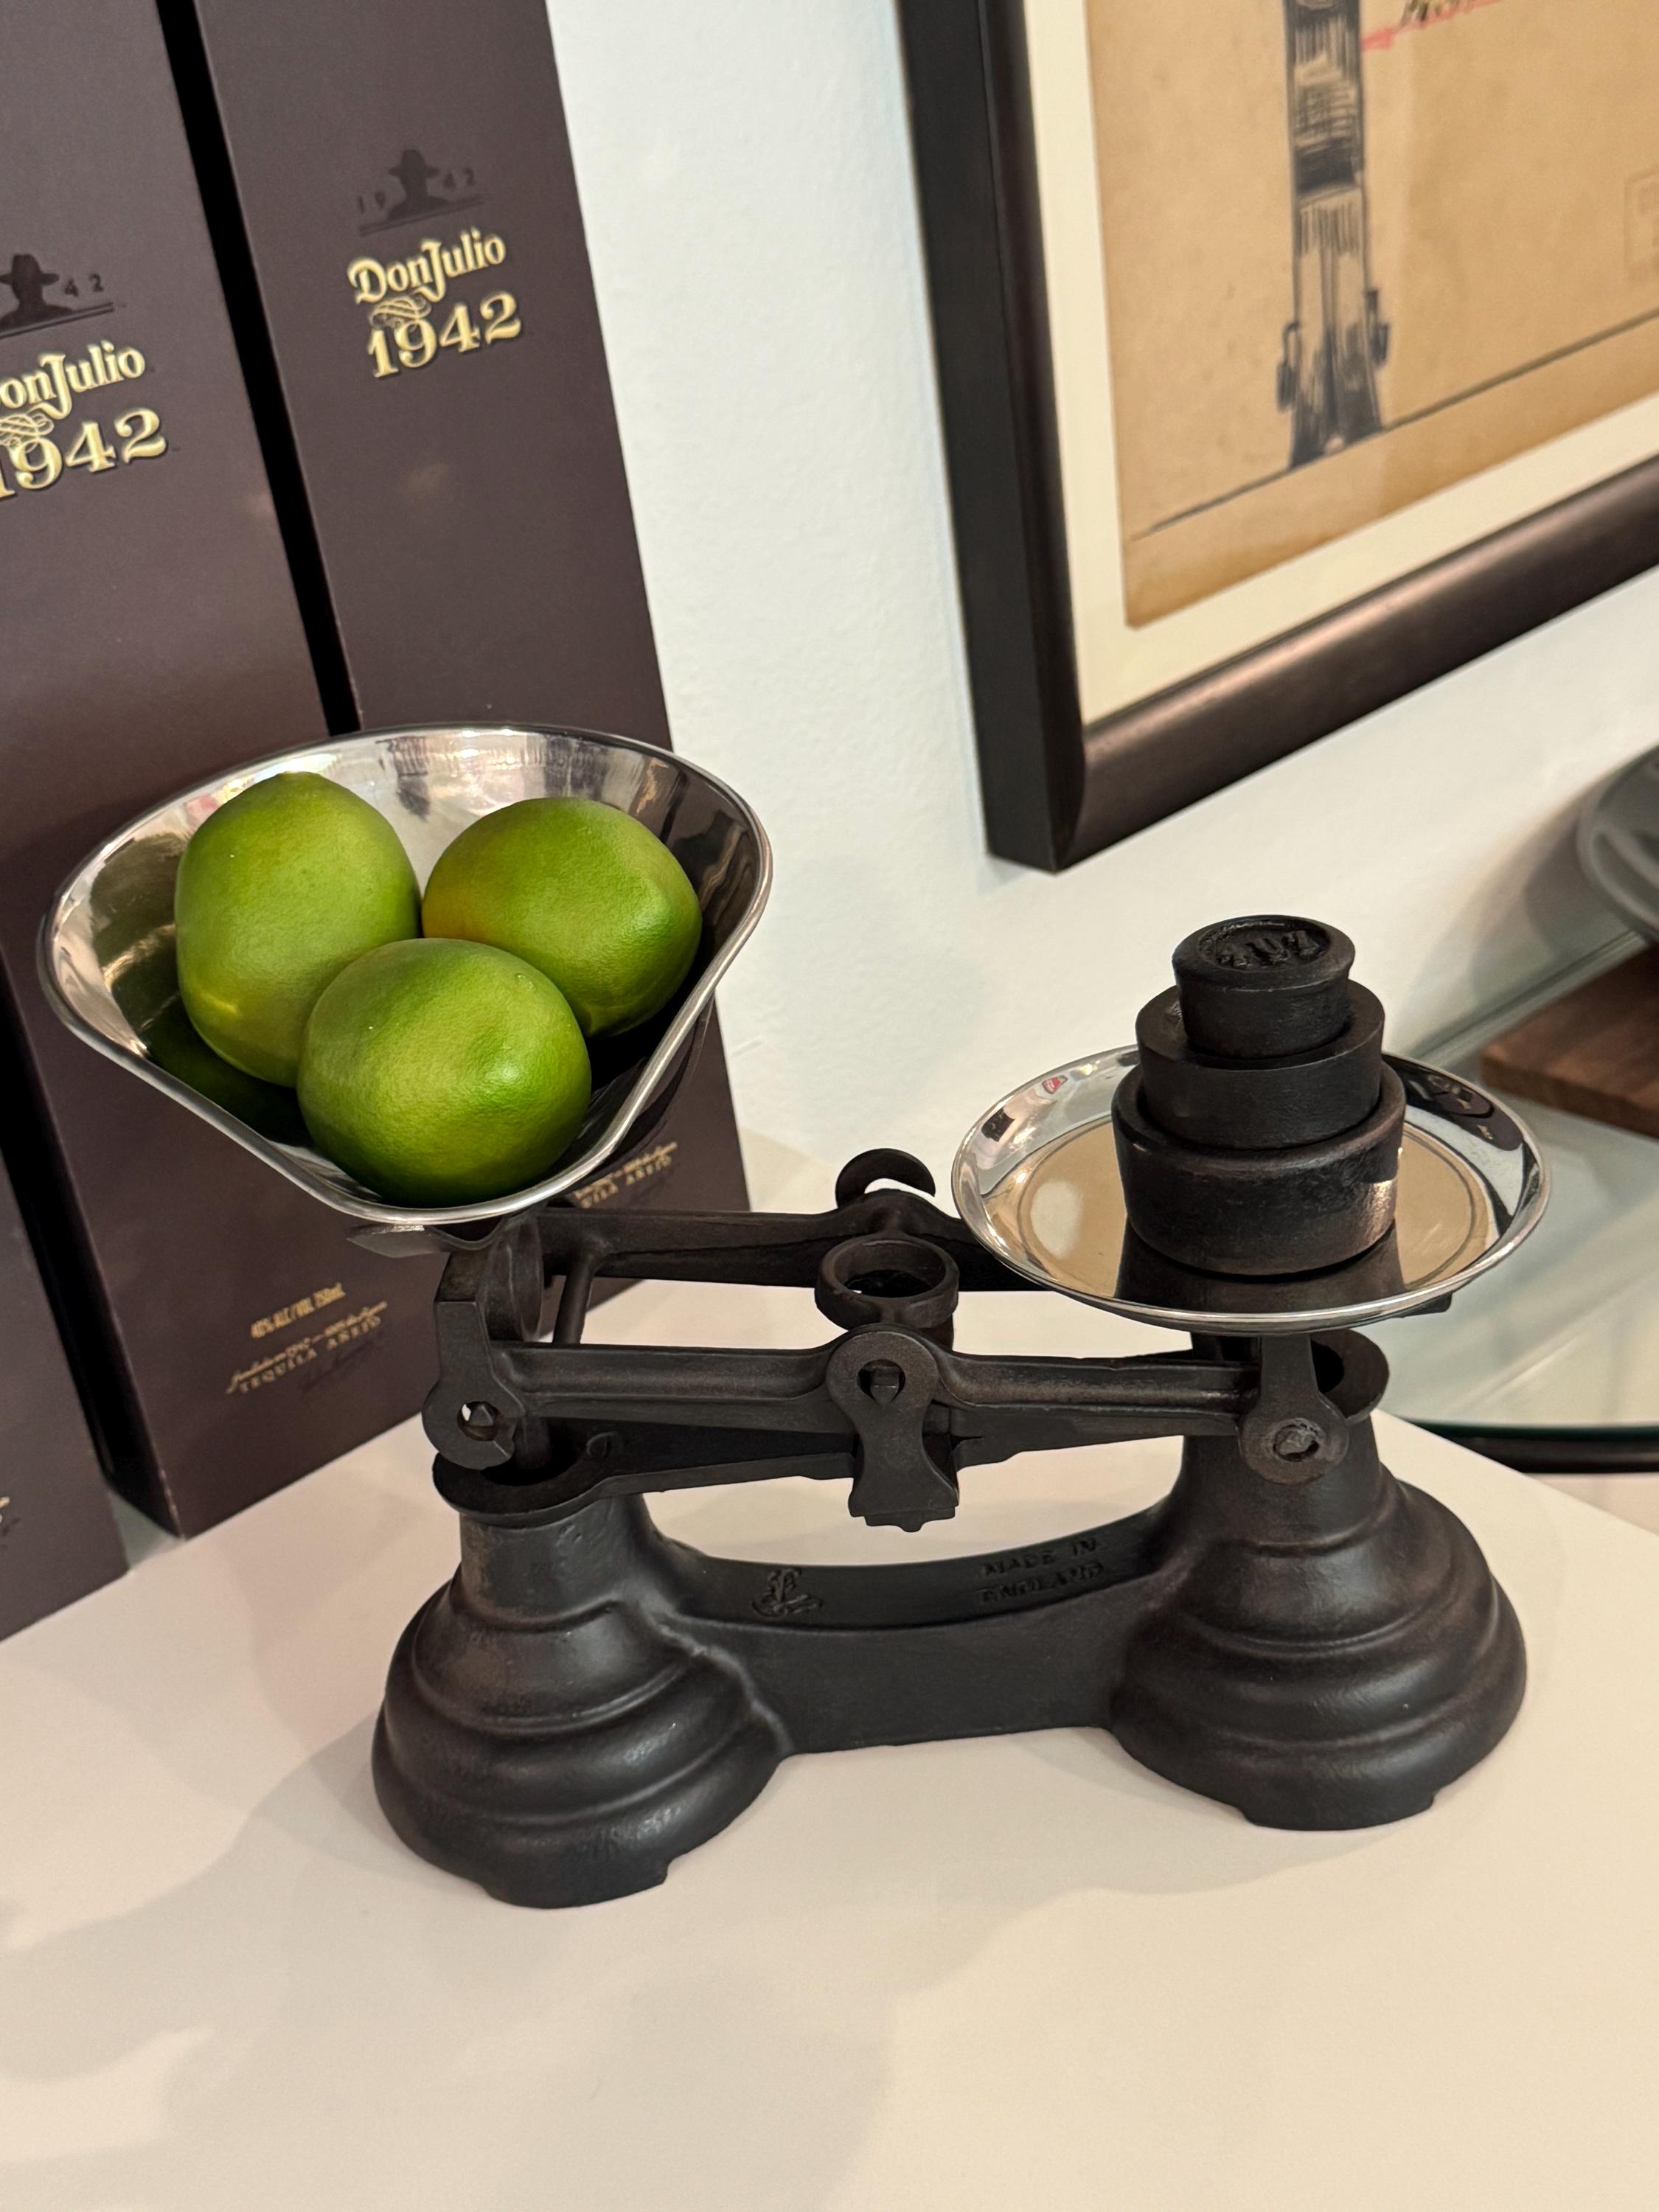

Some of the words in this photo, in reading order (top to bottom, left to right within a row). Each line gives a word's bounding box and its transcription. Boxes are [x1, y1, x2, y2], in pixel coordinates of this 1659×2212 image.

[367, 292, 522, 378] 1942
[240, 1348, 317, 1394] TEQUILA
[976, 1562, 1105, 1602] ENGLAND
